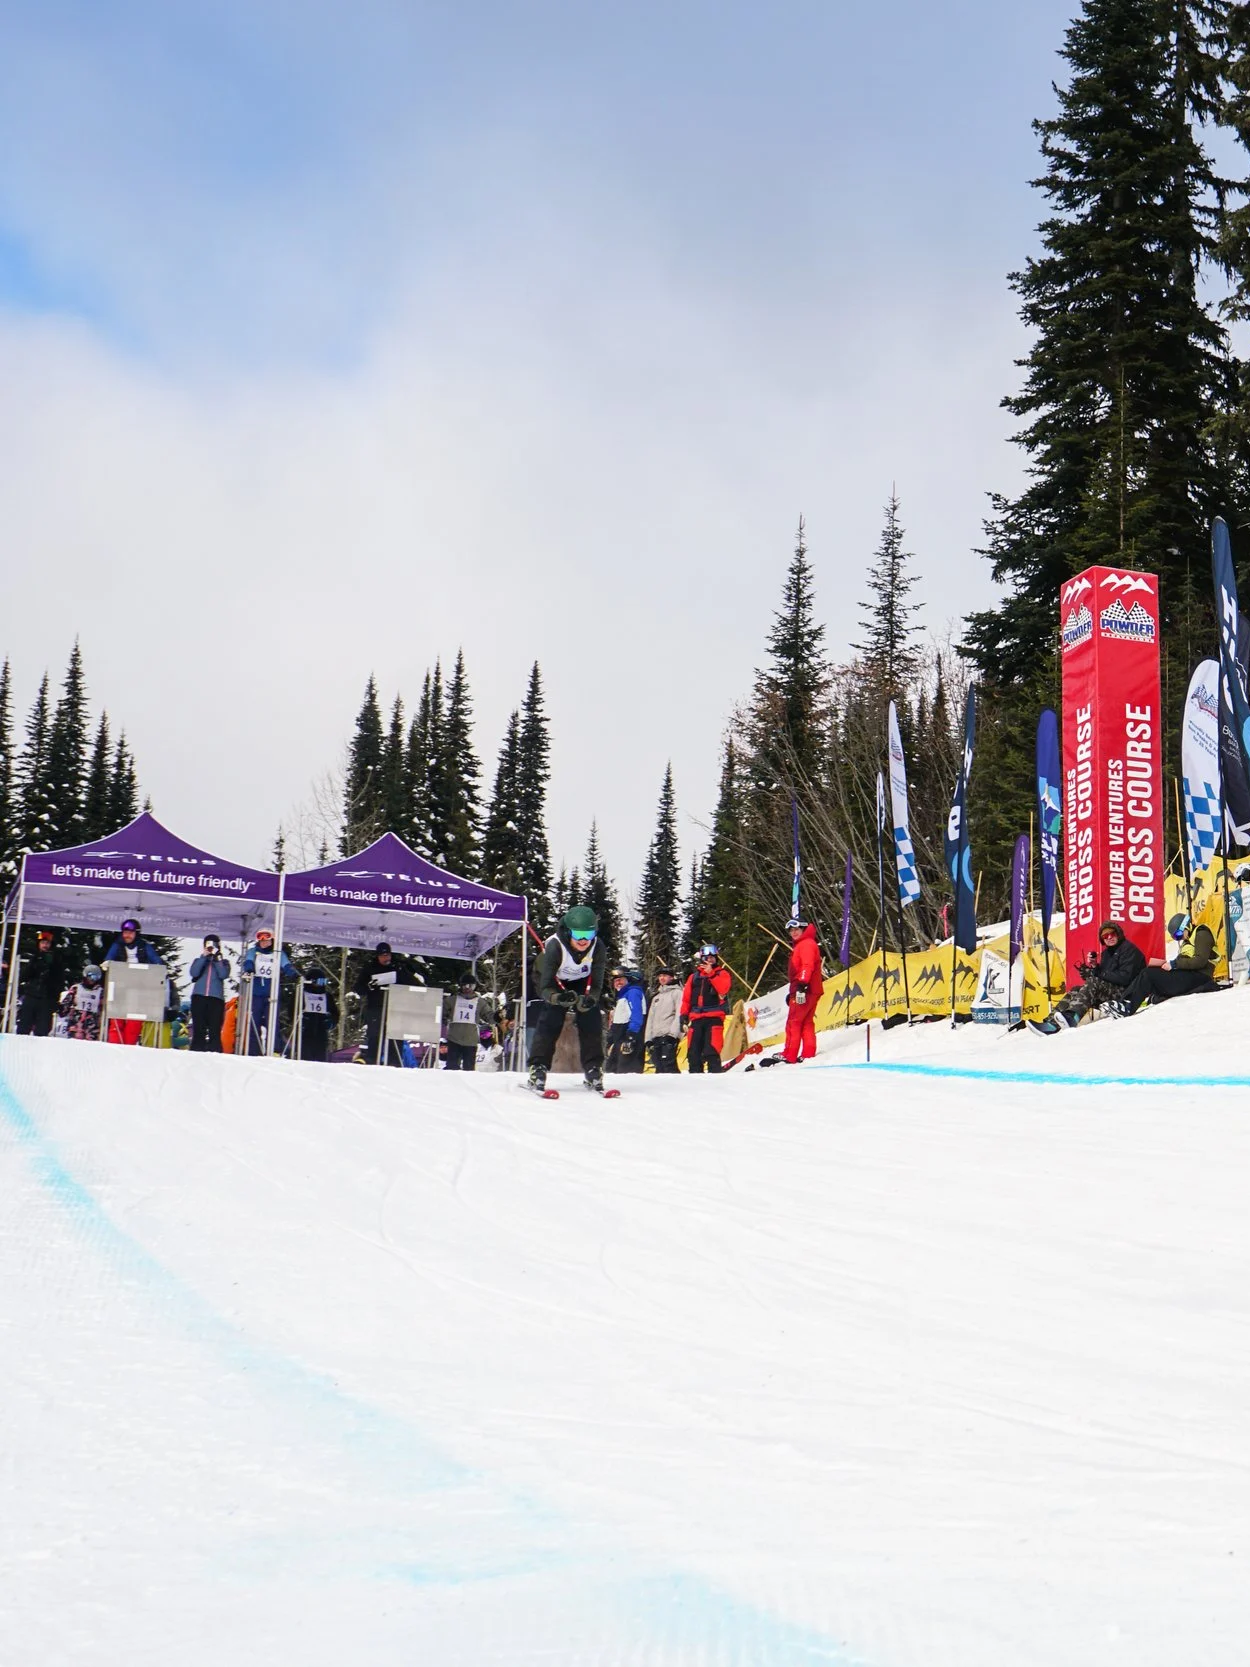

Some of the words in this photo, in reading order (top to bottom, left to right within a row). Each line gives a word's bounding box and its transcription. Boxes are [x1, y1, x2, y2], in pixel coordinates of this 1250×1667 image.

[1076, 703, 1092, 821] COURSE
[1125, 703, 1153, 818] COURSE
[1067, 768, 1077, 852] VENTURES
[1108, 758, 1124, 846] VENTURES
[52, 863, 82, 878] let's
[84, 867, 124, 881] make
[127, 868, 151, 882] the
[153, 871, 196, 887] future
[132, 853, 217, 866] TELUS
[382, 873, 461, 890] TELUS
[1077, 827, 1094, 926] CROSS
[1109, 851, 1126, 922] POWDER
[1127, 827, 1154, 924] CROSS
[310, 883, 338, 898] let's
[340, 888, 378, 902] make
[380, 889, 403, 904] the
[404, 893, 445, 908] future
[1069, 860, 1078, 931] POWDER
[260, 966, 272, 975] 66
[311, 1003, 321, 1012] 16
[460, 1011, 470, 1020] 14
